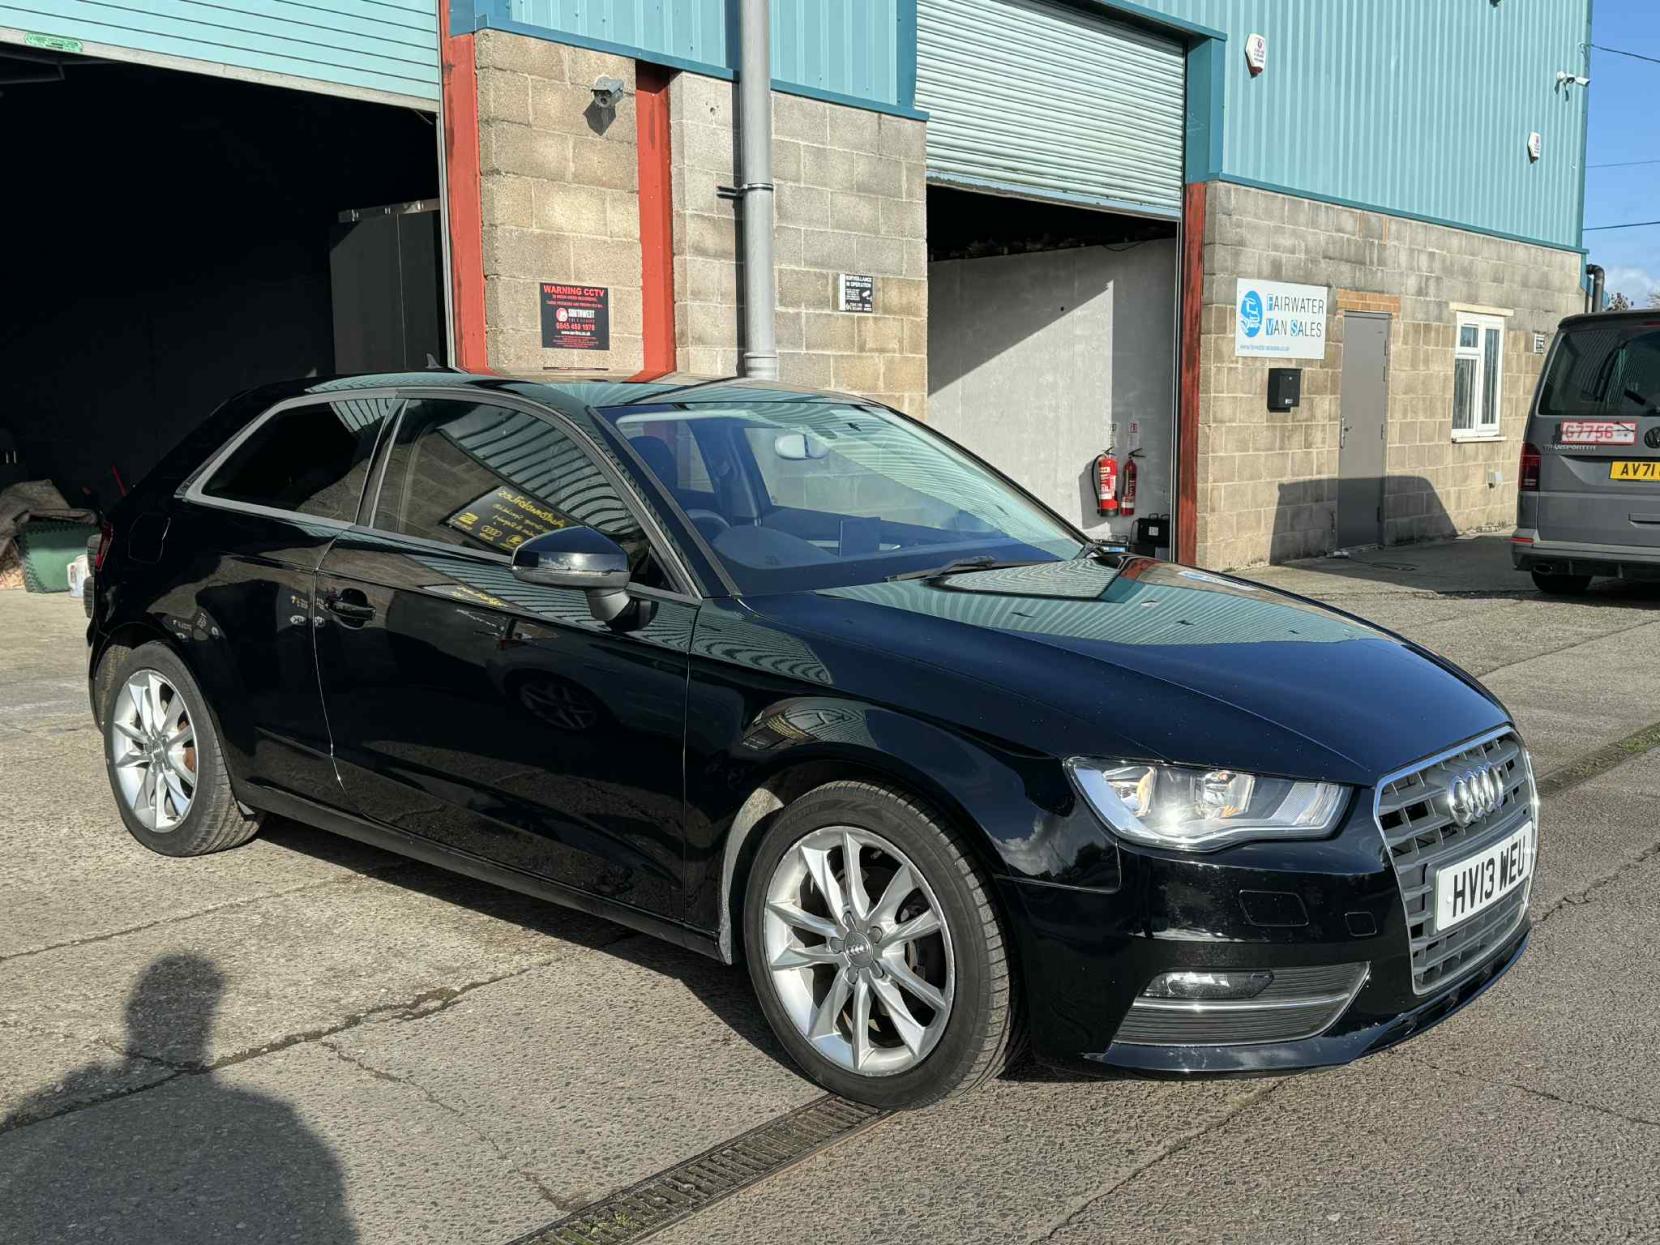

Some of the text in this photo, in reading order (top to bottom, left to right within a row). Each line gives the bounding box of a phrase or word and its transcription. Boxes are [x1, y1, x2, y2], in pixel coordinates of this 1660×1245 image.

[544, 285, 604, 296] WARNING CCTV
[1266, 293, 1325, 314] FAIRWATER
[1265, 318, 1322, 337] VAN SALES
[1620, 463, 1656, 477] AV71
[1453, 835, 1526, 917] HV13 WEU
